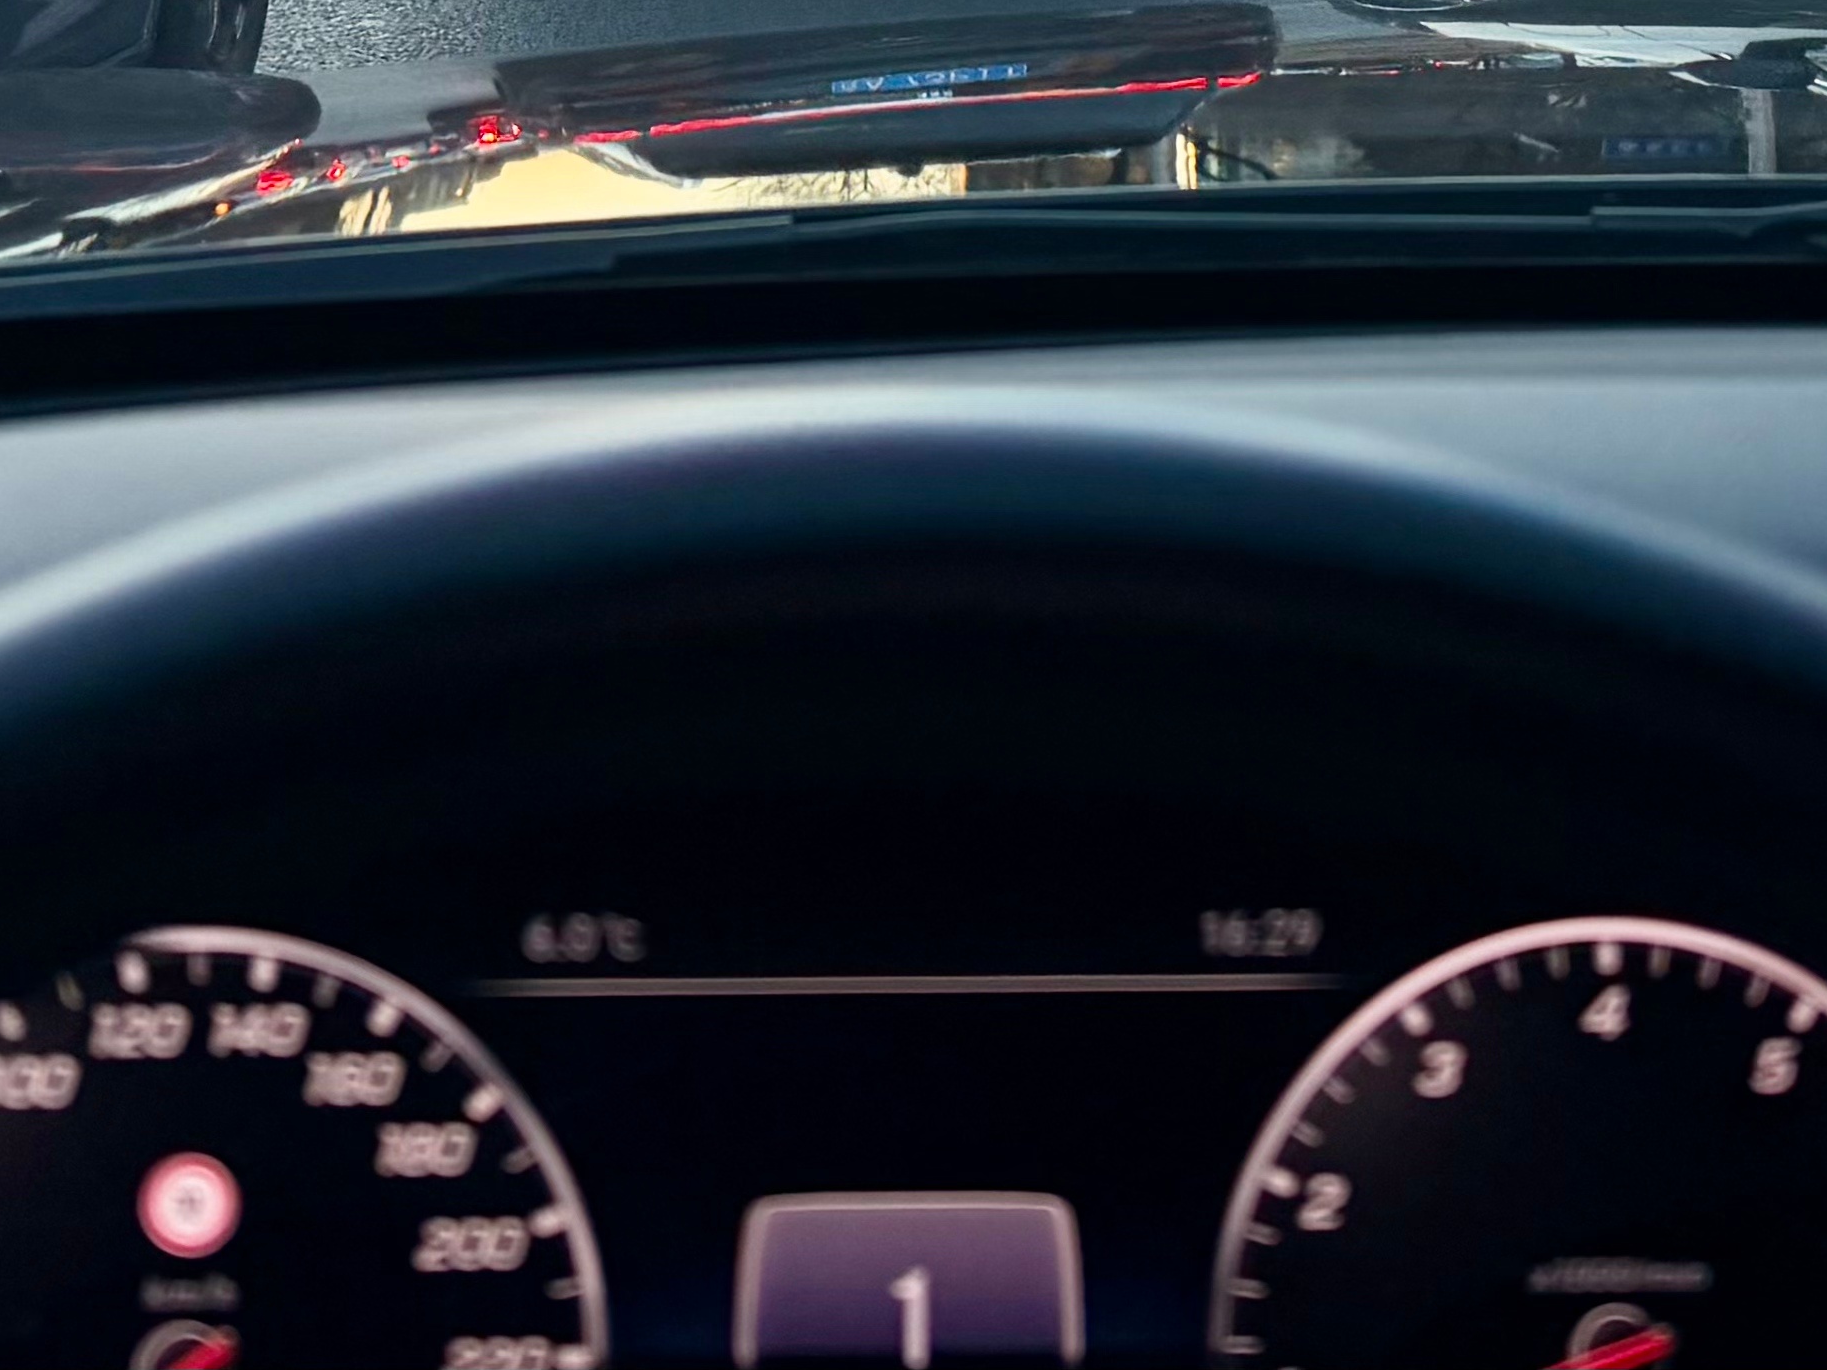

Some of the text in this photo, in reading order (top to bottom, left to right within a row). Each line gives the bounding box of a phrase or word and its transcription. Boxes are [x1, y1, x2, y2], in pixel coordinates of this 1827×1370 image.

[1579, 984, 1632, 1041] 4
[1412, 1041, 1469, 1099] 3
[1749, 1037, 1801, 1095] 5
[1296, 1171, 1352, 1232] 2
